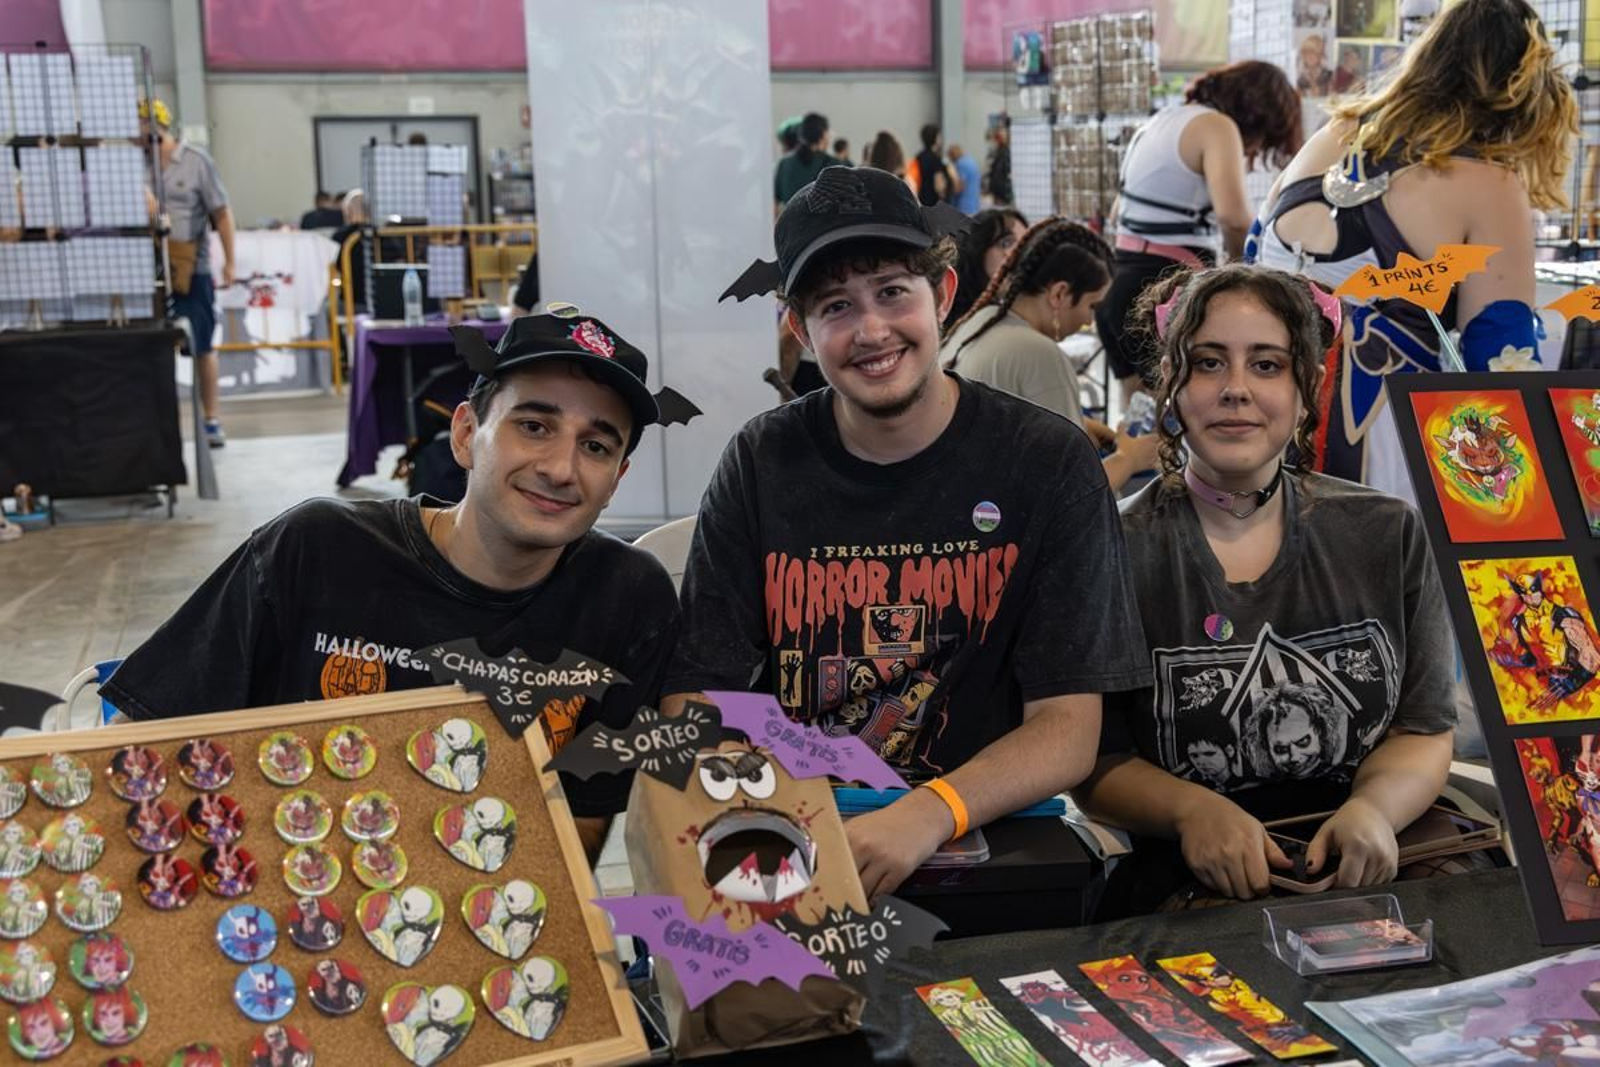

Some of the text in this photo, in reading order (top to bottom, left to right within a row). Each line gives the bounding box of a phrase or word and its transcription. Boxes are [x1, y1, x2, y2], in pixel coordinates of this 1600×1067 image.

[1368, 263, 1449, 287] 1 PRINTS
[1409, 280, 1440, 296] 4€
[810, 540, 980, 558] I FREAKING LOVE
[765, 552, 891, 648] HORROR
[314, 632, 430, 672] HALLOWEE
[442, 652, 599, 687] CHAPAS CORAZÓN
[497, 687, 532, 706] 3€
[612, 723, 700, 761] SORTEO
[765, 720, 838, 763] GRATIS
[663, 920, 749, 965] GRATIS
